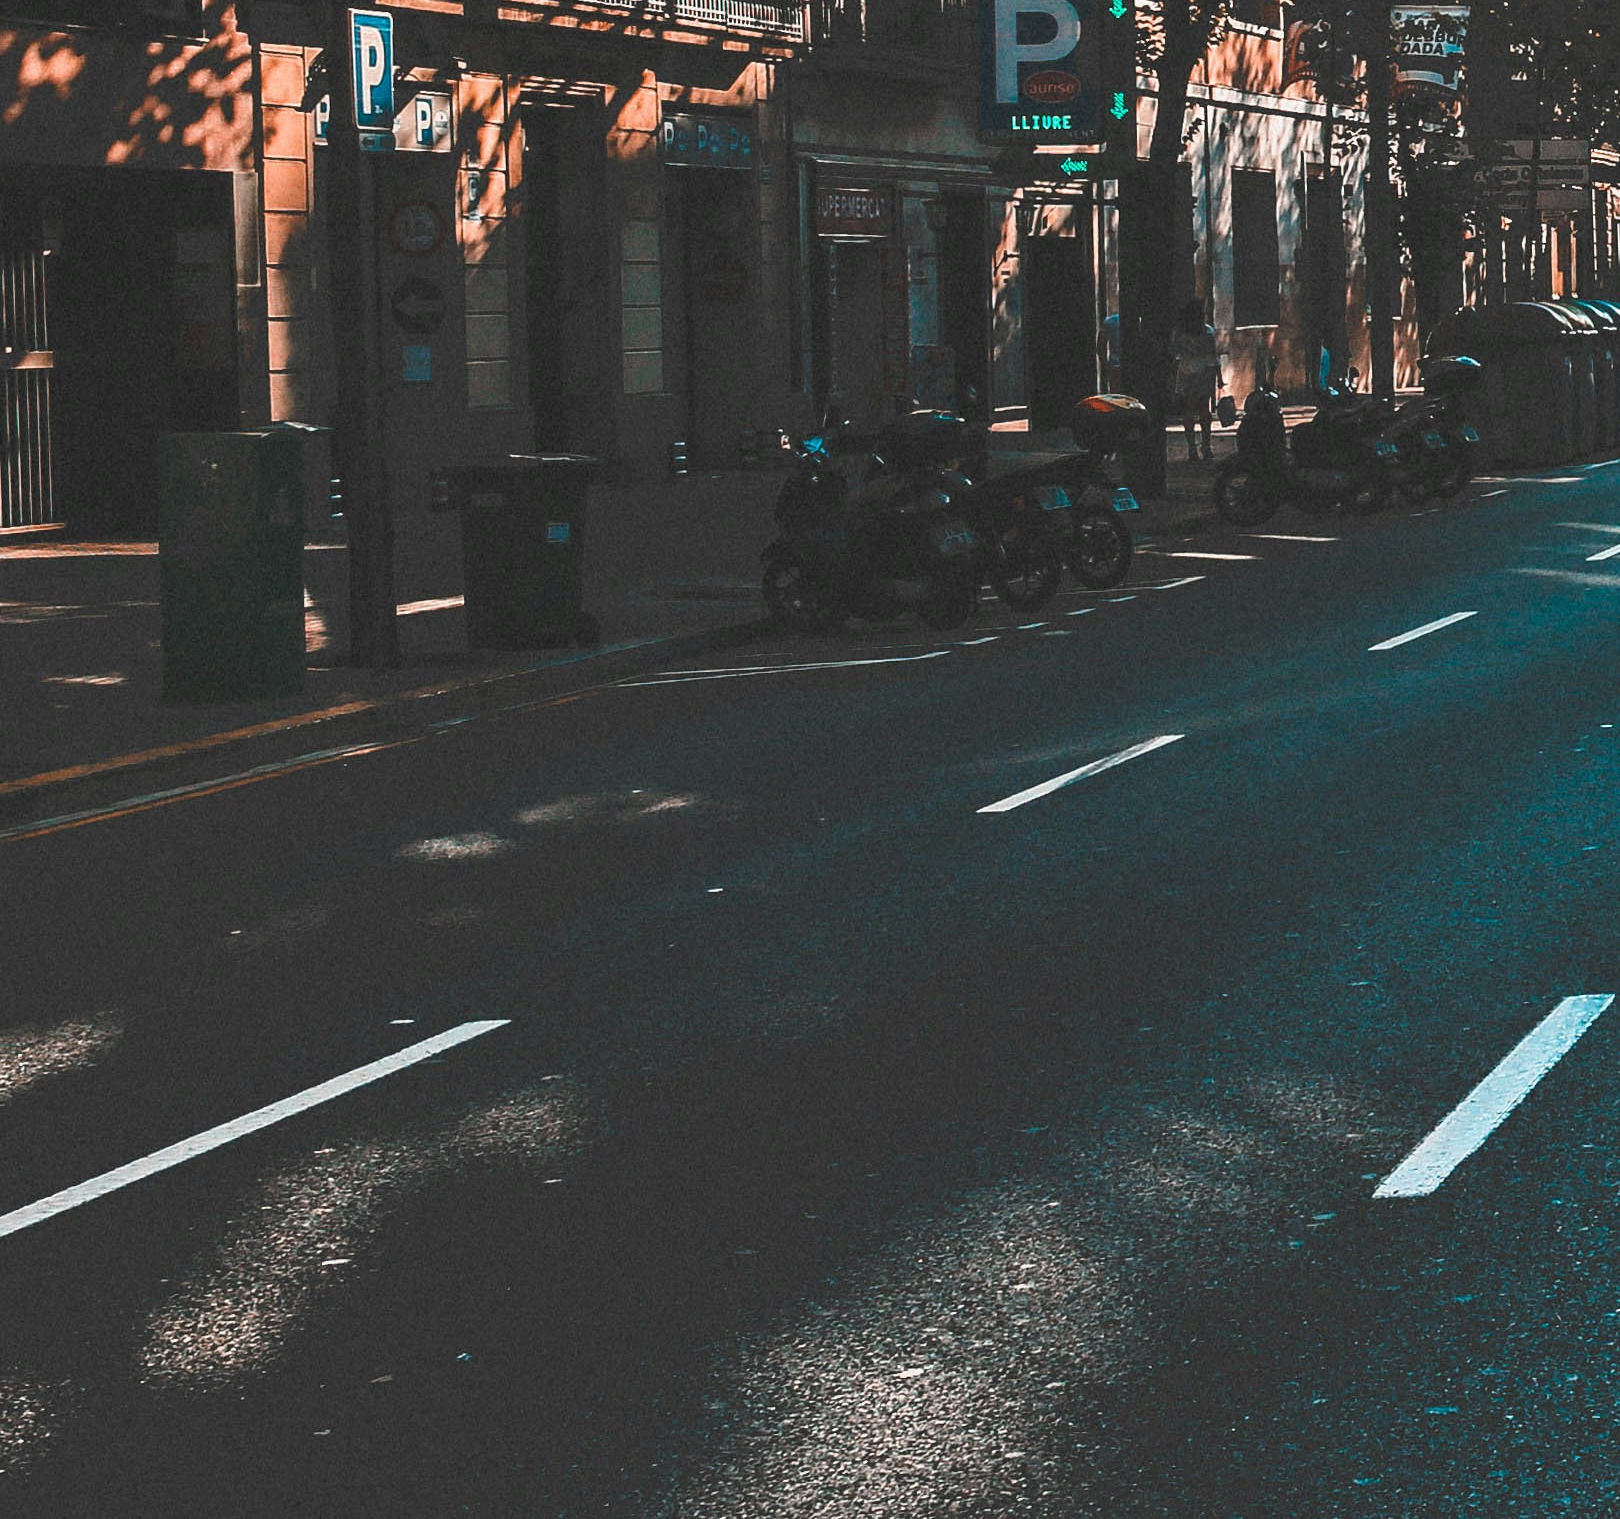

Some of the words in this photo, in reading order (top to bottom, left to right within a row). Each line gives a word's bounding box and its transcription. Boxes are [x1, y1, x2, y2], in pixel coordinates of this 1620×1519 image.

[359, 24, 386, 115] P
[417, 100, 431, 142] P
[1011, 115, 1072, 130] LLIURE
